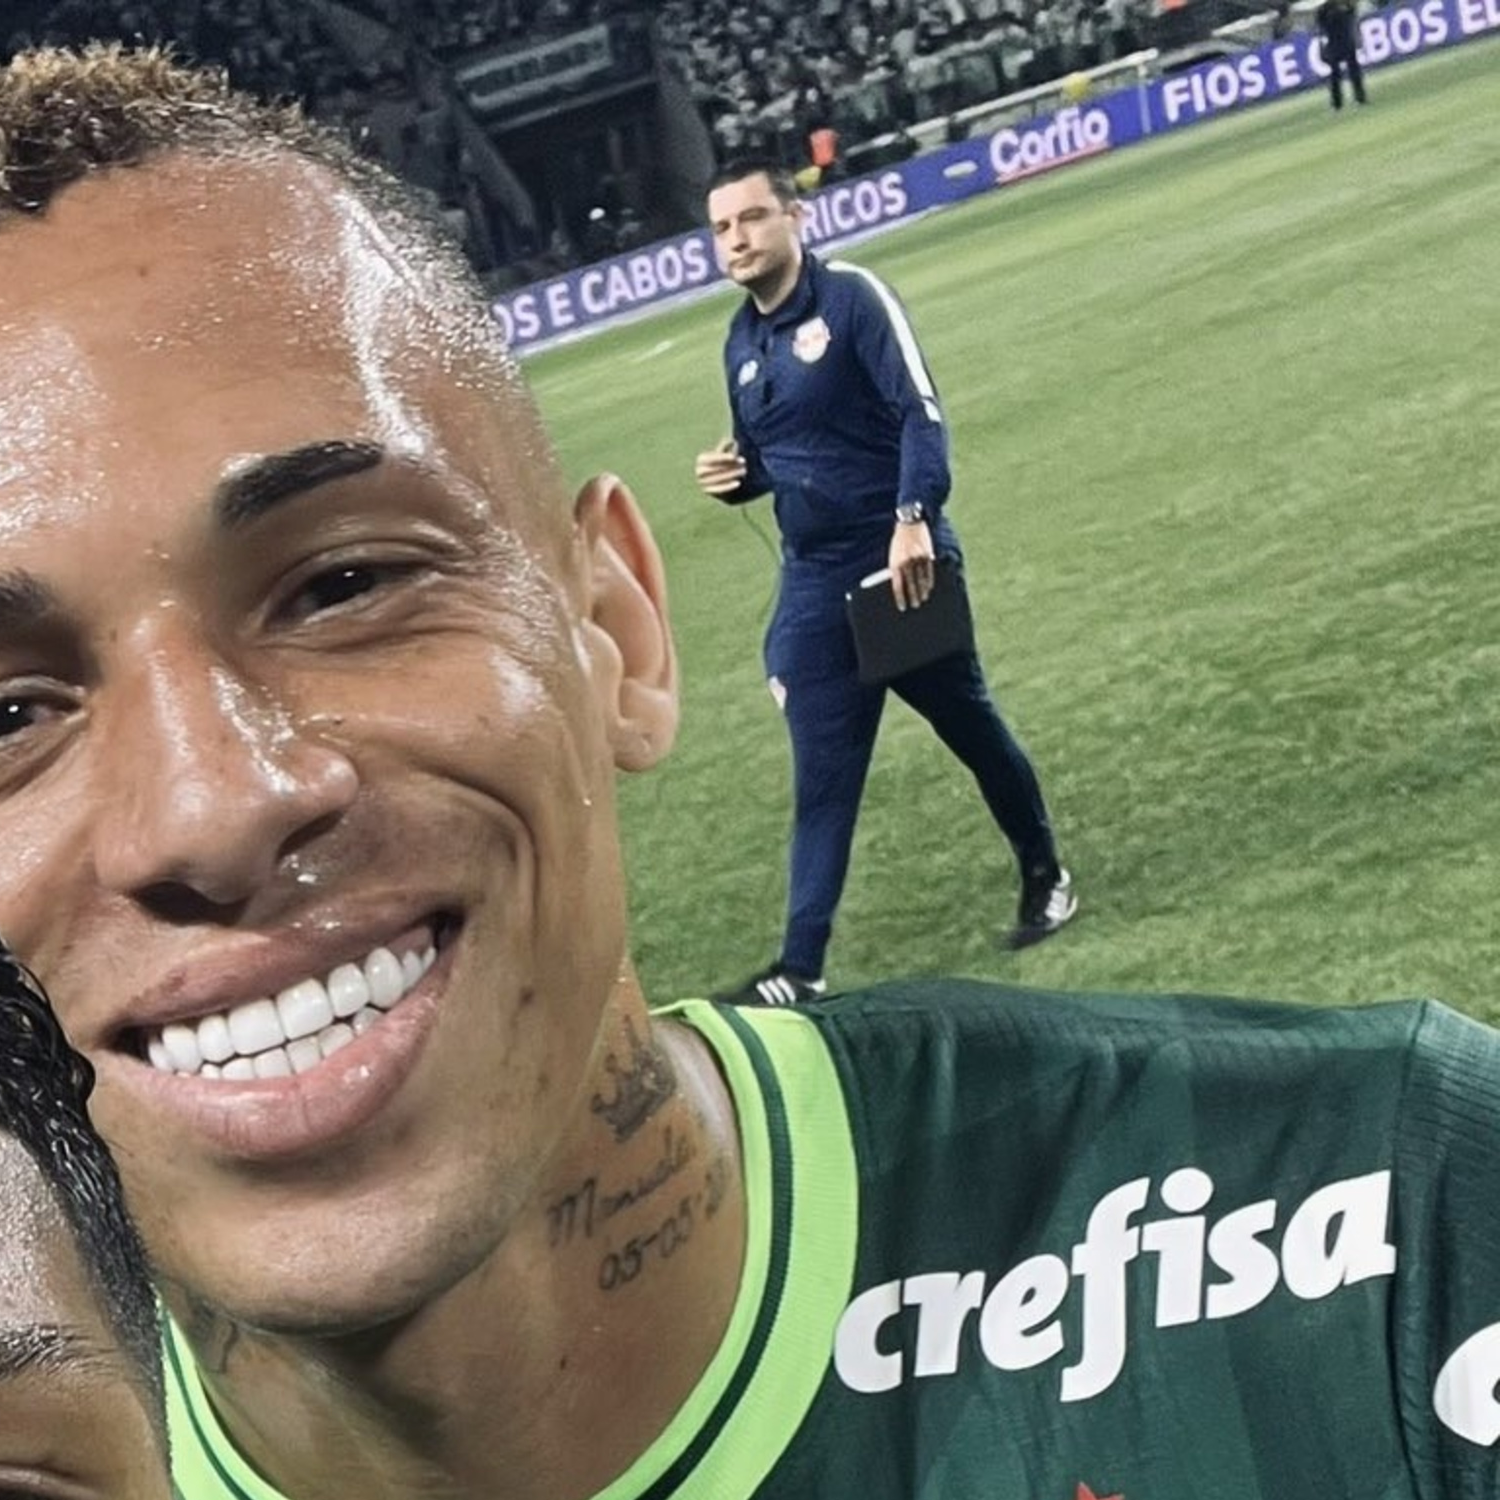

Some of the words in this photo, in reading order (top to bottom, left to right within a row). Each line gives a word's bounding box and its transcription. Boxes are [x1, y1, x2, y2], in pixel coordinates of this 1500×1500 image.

[1163, 54, 1266, 122] FIOS
[1272, 45, 1301, 88] E
[1308, 1, 1448, 77] CBOS
[990, 108, 1109, 173] Corfio
[546, 282, 576, 327] E
[580, 238, 709, 314] CABOS
[800, 171, 907, 242] RICOS
[833, 1167, 1397, 1402] crefisa
